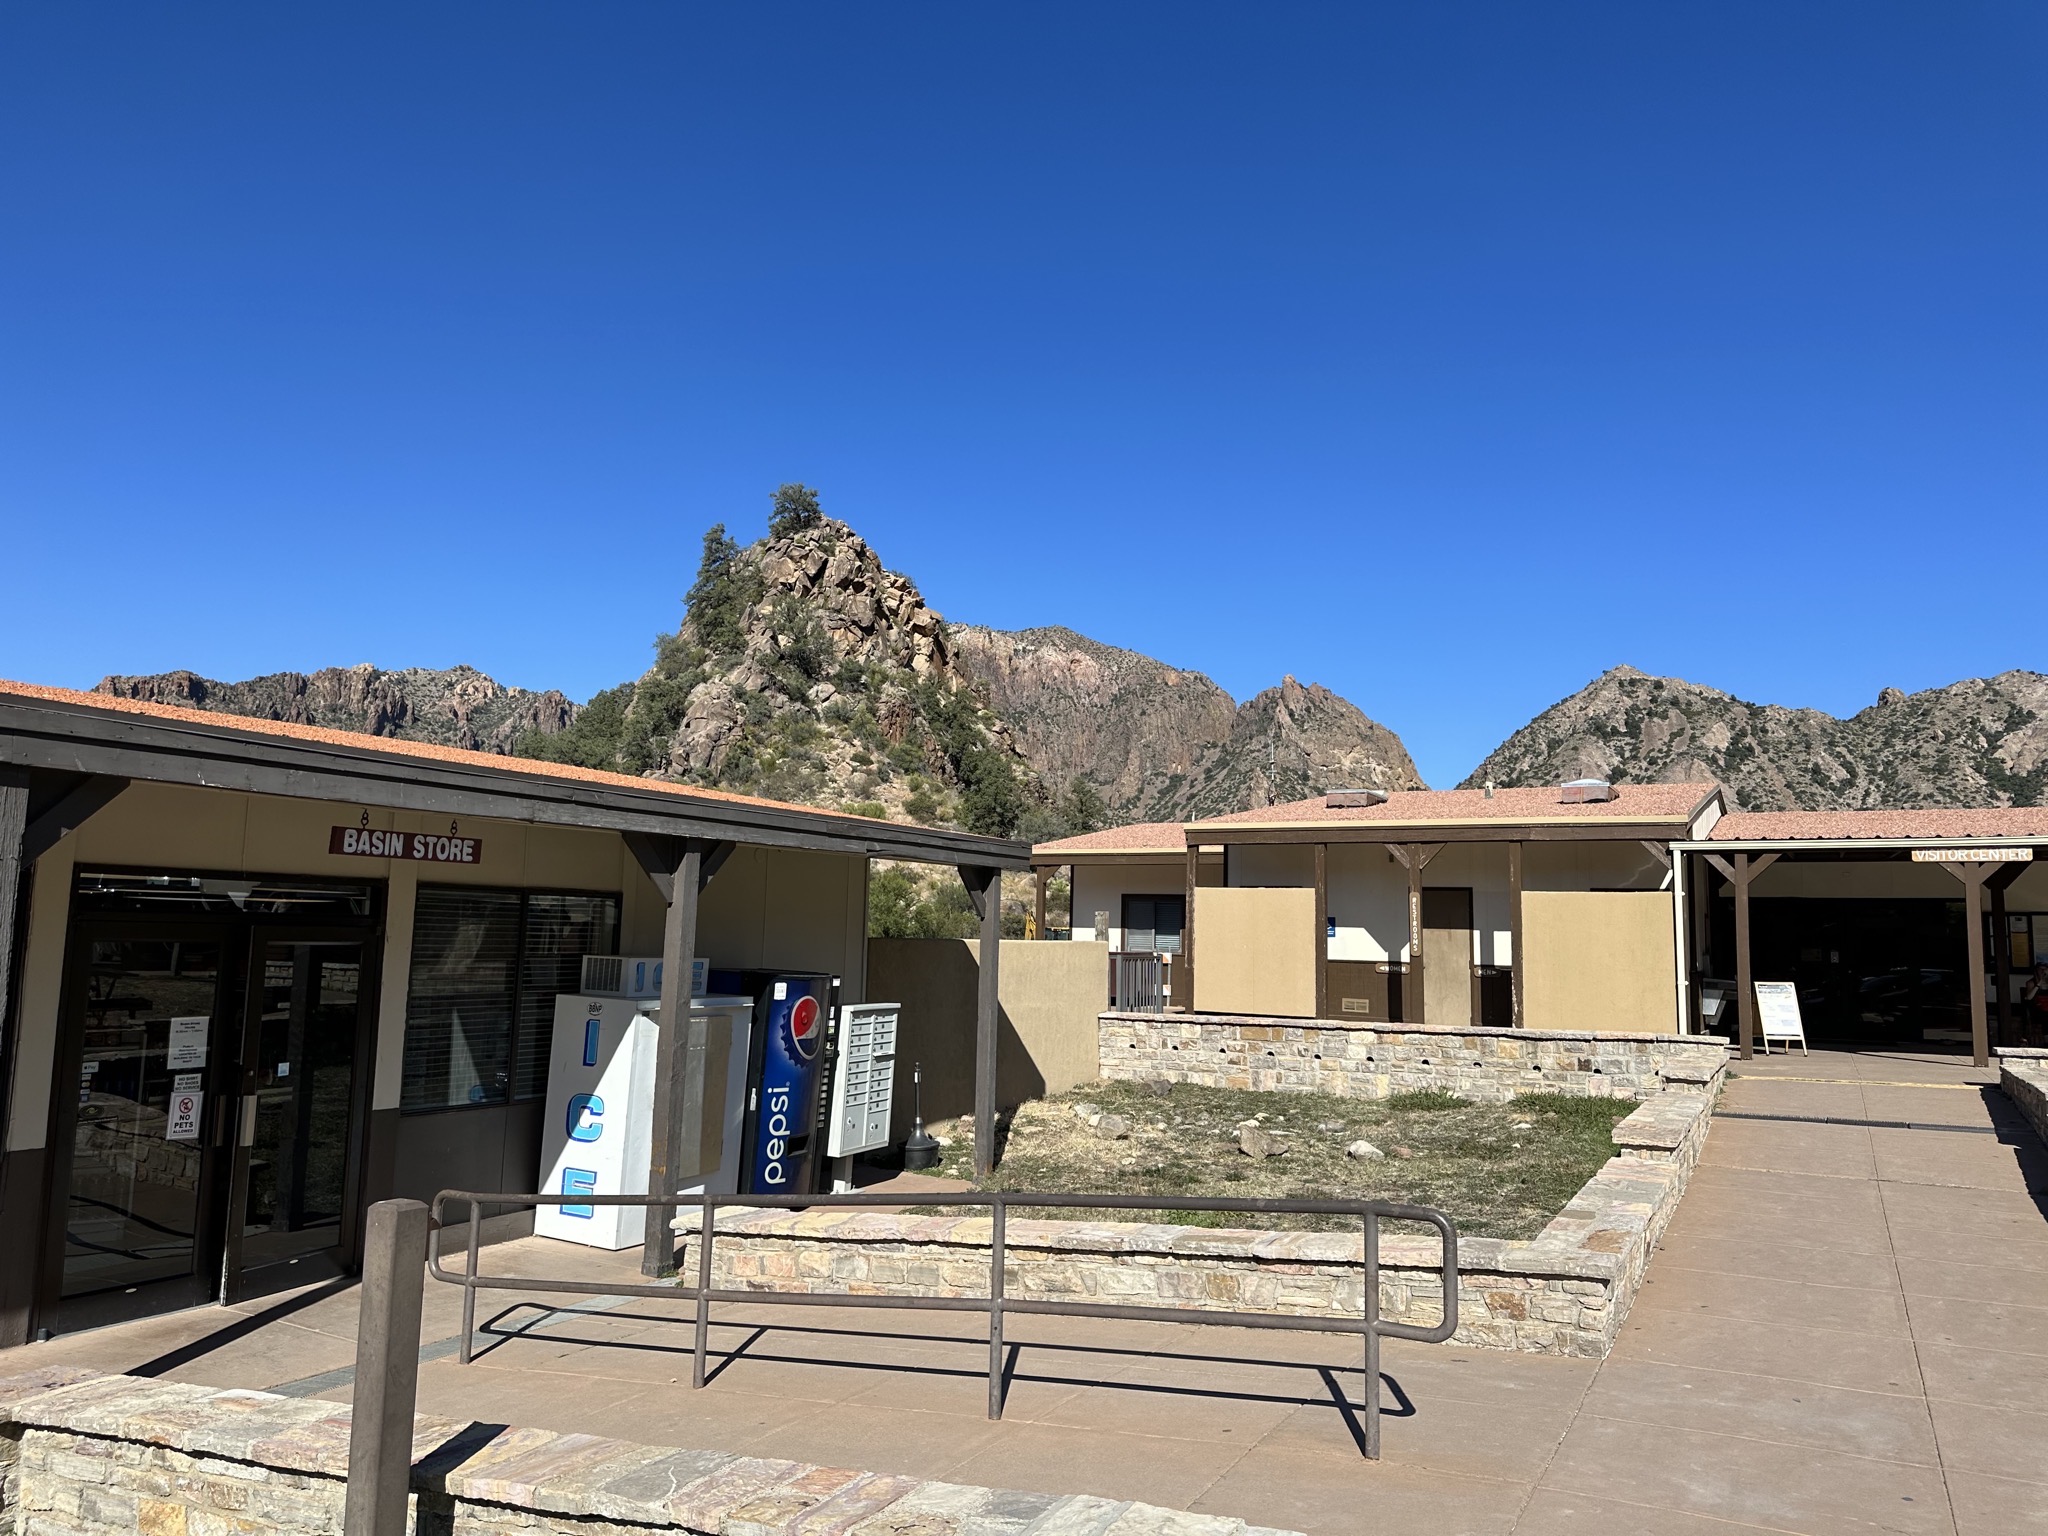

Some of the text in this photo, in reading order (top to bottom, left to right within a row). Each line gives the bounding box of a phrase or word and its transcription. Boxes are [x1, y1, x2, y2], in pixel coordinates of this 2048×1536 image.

[343, 828, 475, 862] BASIN STORE
[1916, 848, 2028, 860] VISITOR CENTER
[1478, 968, 1492, 976] MEN
[174, 1121, 193, 1129] PETS
[765, 1086, 791, 1185] pepsi
